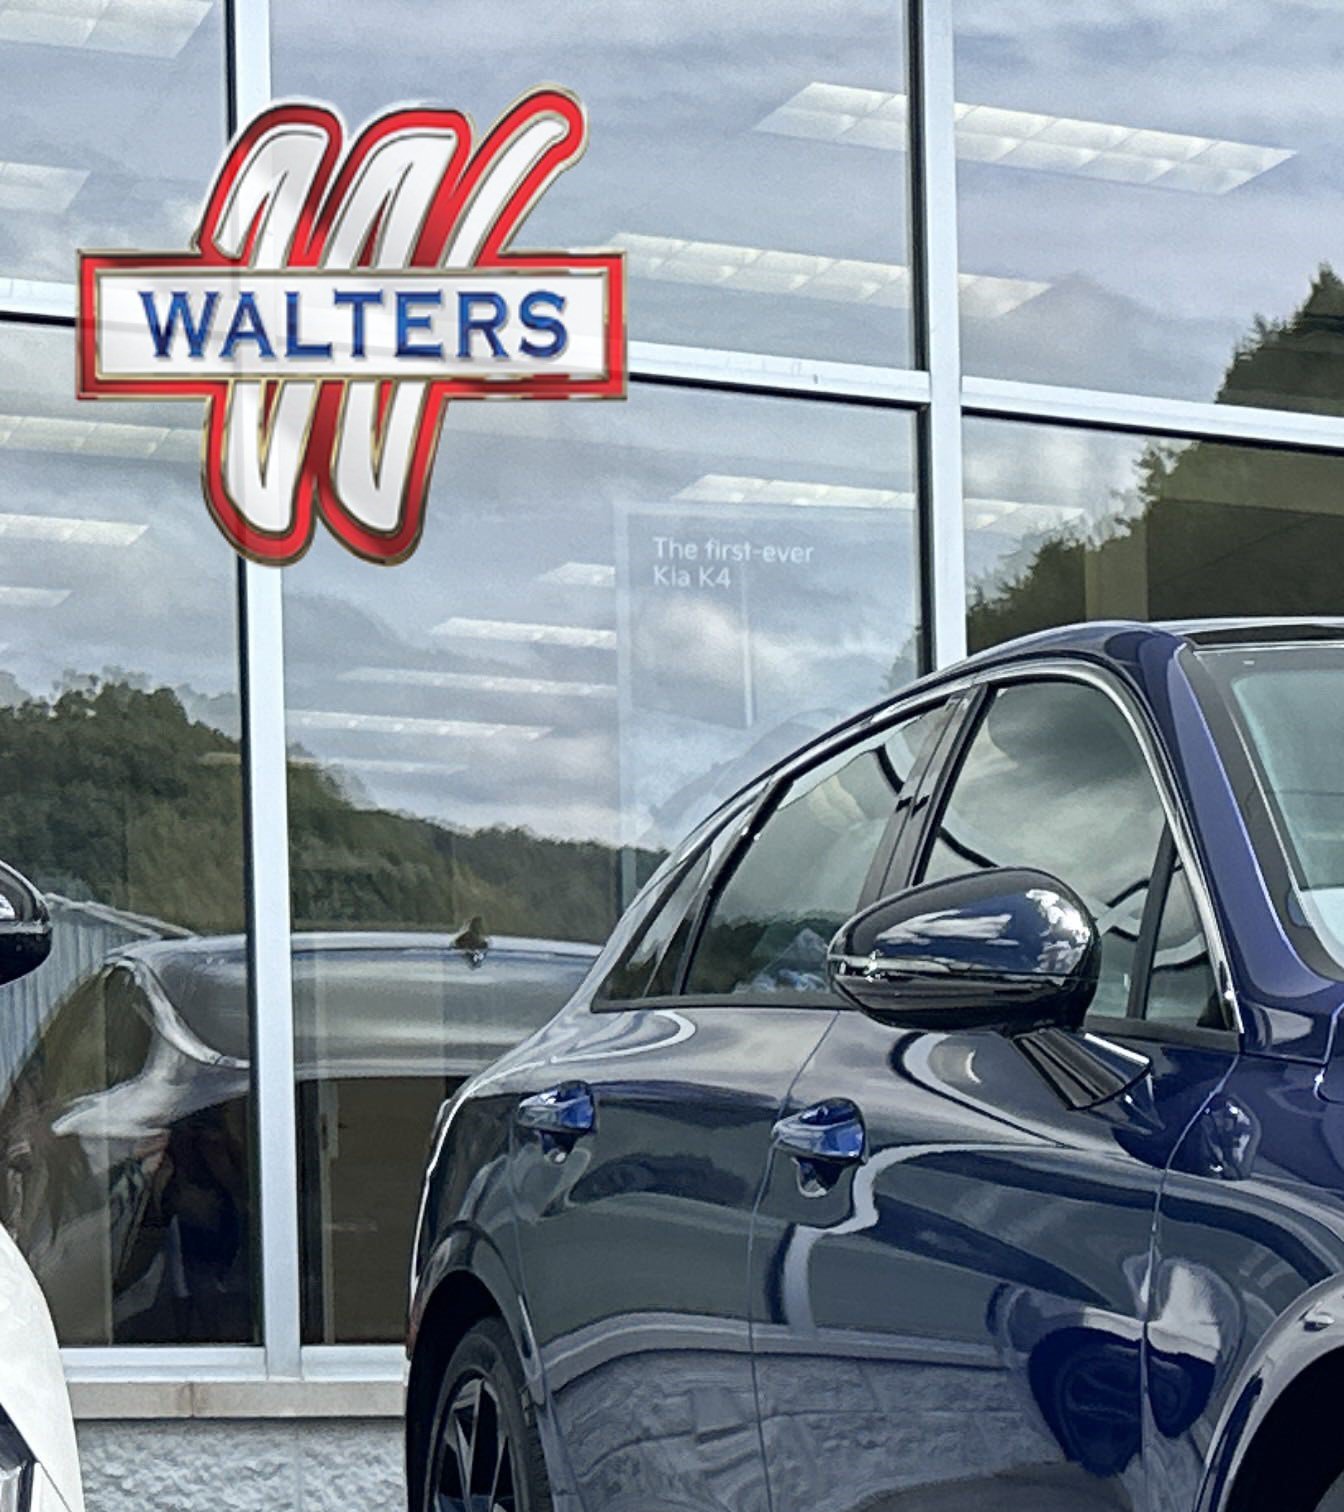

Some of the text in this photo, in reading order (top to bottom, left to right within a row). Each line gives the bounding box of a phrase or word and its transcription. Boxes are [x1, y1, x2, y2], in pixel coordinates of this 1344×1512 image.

[653, 536, 815, 564] The first-ever
[653, 564, 731, 589] Kia K4
